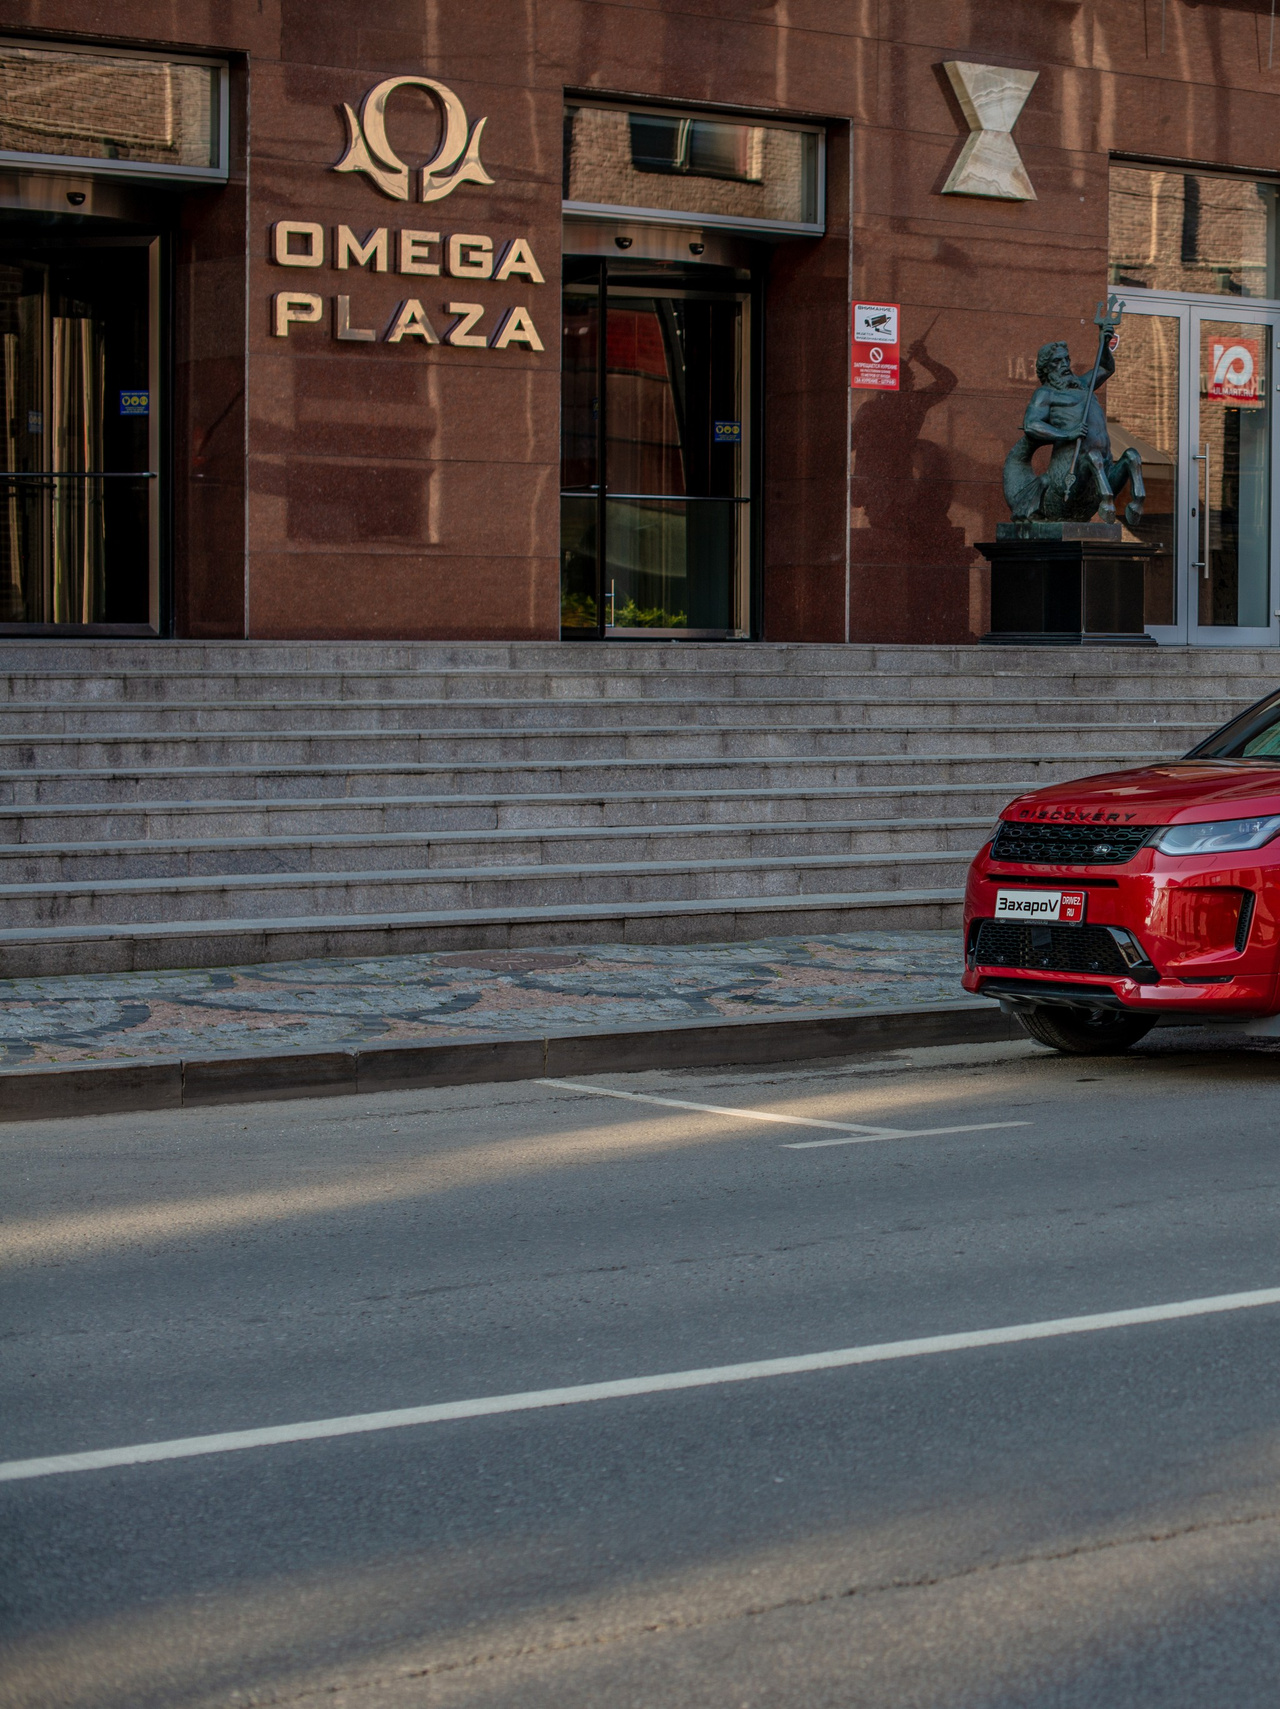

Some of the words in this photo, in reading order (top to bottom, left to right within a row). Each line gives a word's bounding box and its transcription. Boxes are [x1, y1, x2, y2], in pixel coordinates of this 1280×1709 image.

[274, 219, 546, 284] OMEGA
[274, 290, 546, 352] PLAZA
[1213, 386, 1254, 398] ULMART.RU
[1019, 809, 1137, 822] DISCOVERY
[1066, 908, 1075, 917] RU
